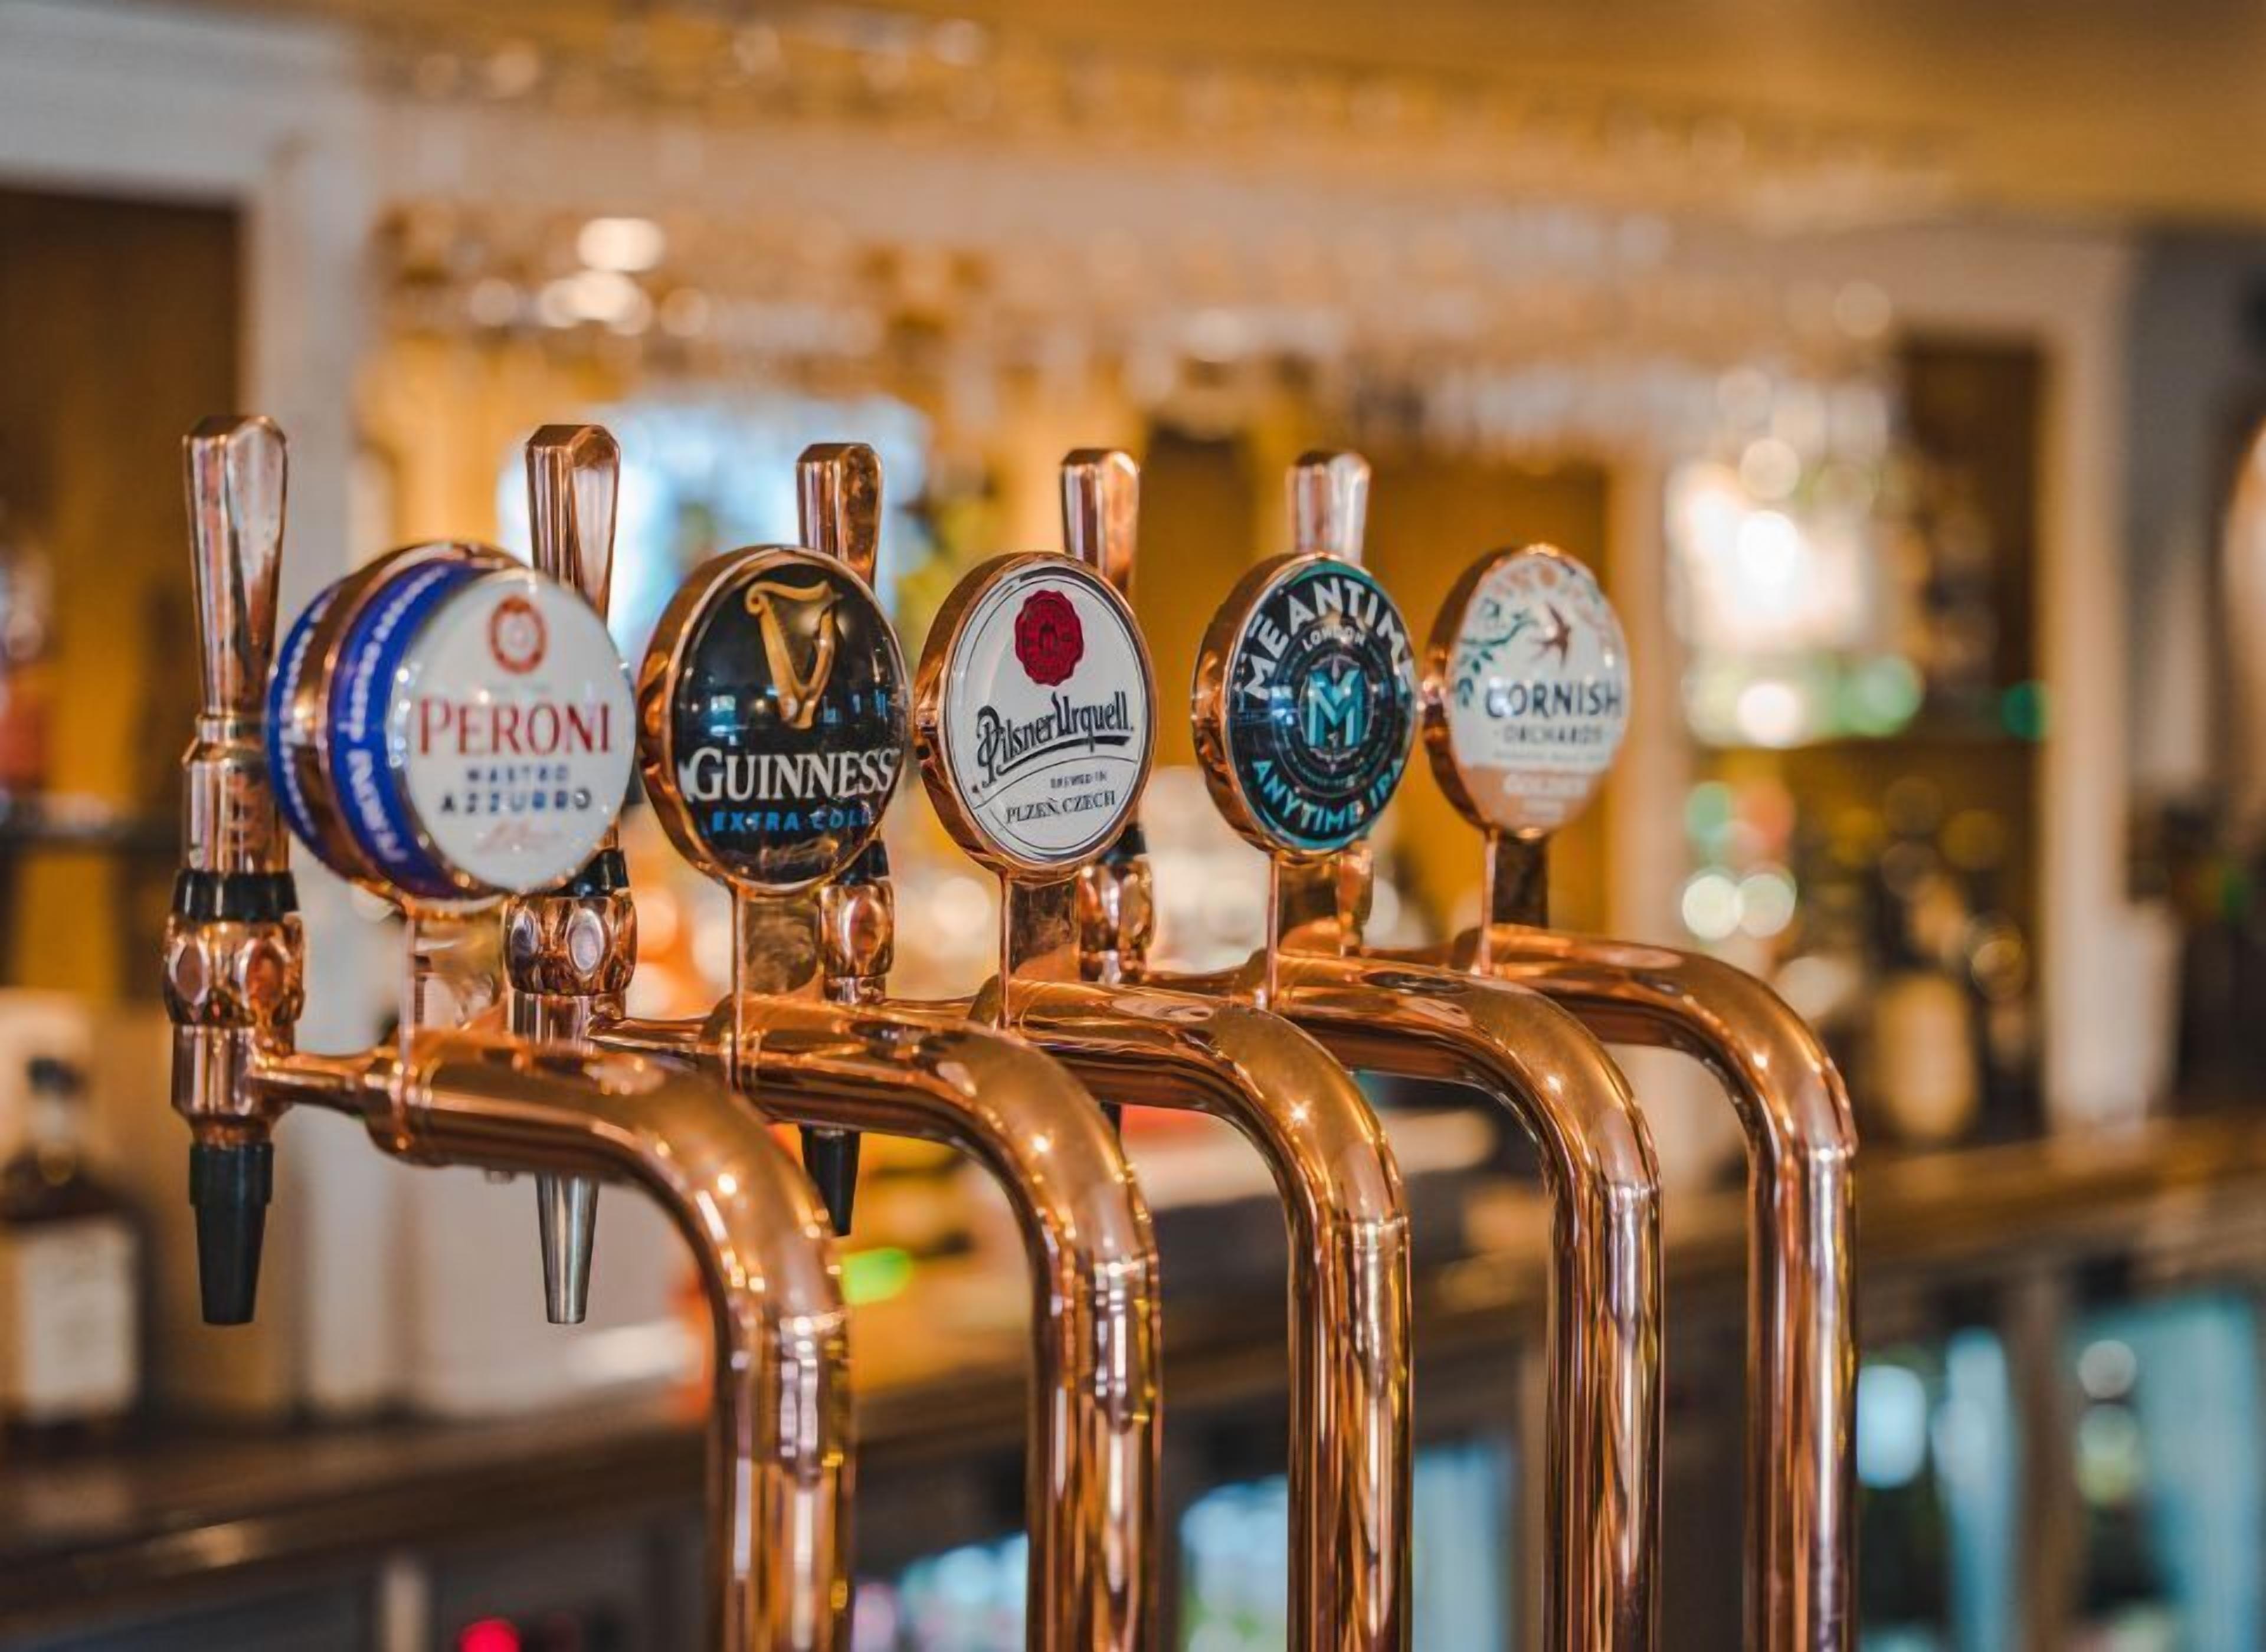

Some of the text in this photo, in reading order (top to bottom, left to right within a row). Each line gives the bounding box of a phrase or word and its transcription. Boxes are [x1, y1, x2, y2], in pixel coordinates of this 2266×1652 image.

[420, 697, 611, 755] PERONI
[1485, 681, 1623, 719] CORNISH
[975, 691, 1130, 788] Pilsner Urquell
[687, 746, 900, 802] GUINNESS
[1062, 791, 1115, 813] CZECH
[1252, 759, 1365, 832] ANYTIME
[712, 810, 800, 832] EXTRA
